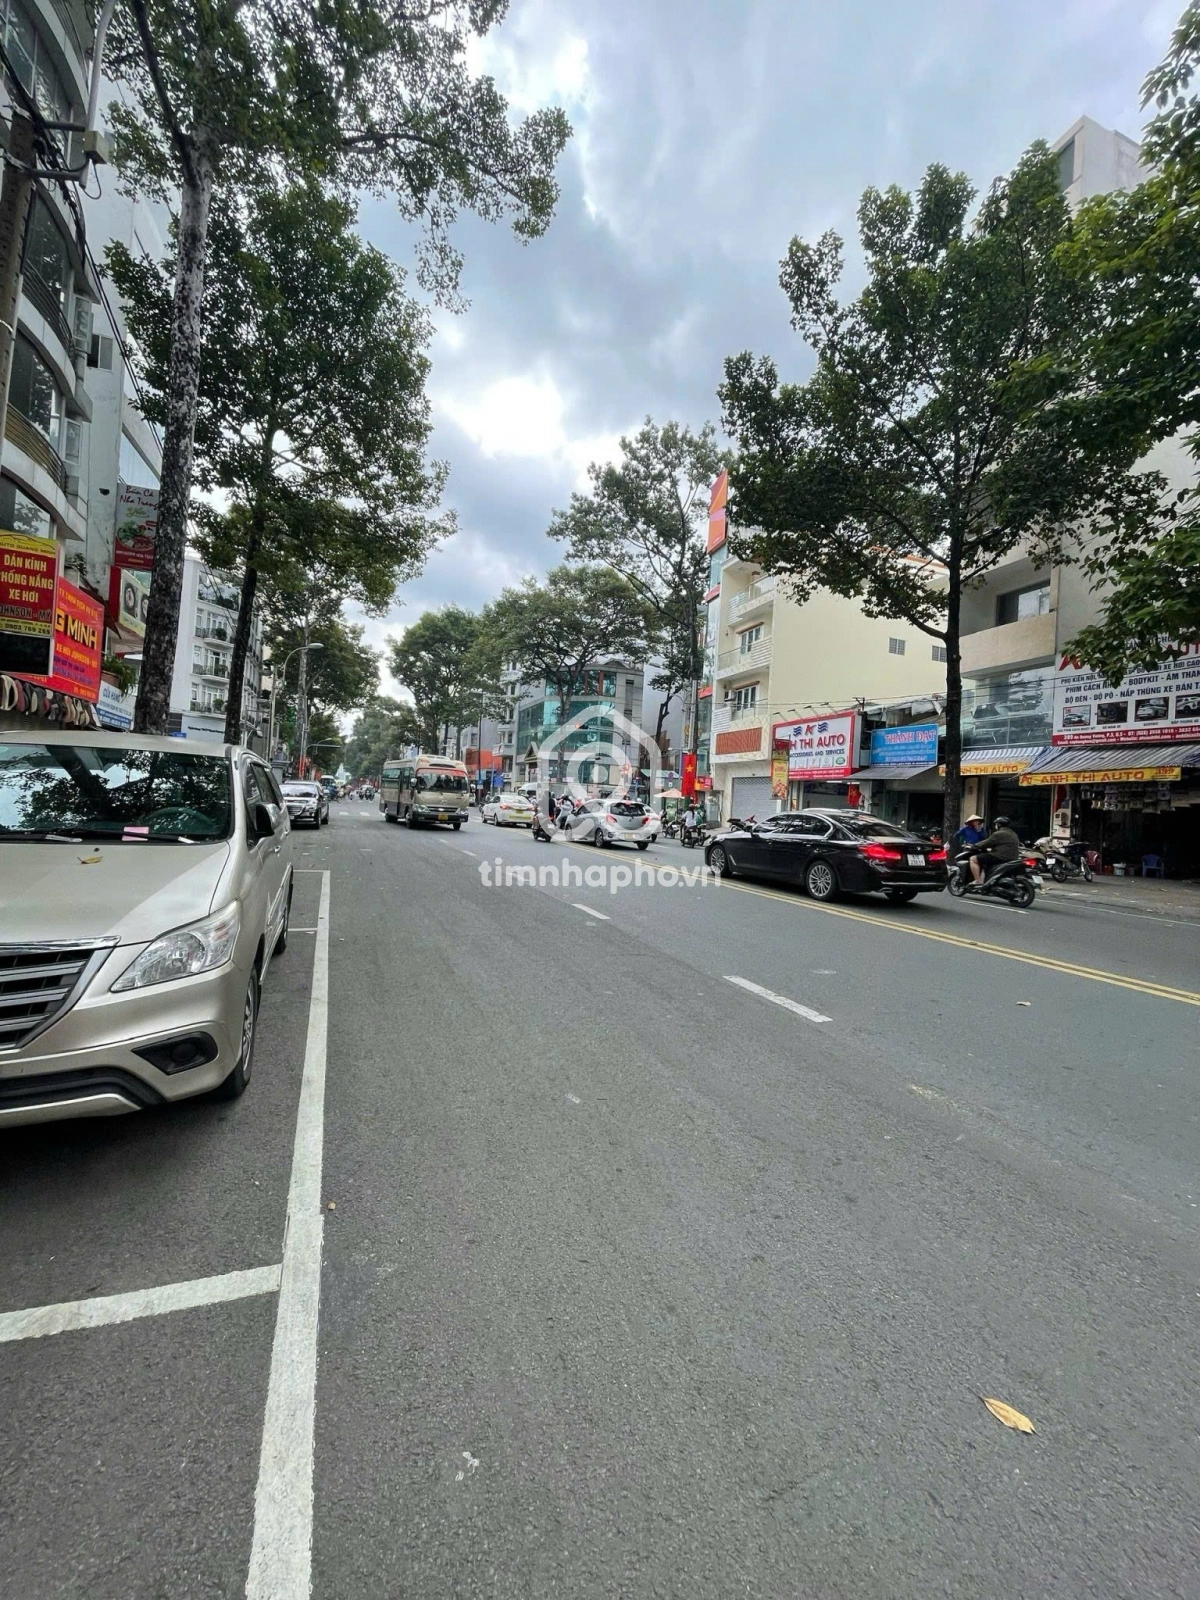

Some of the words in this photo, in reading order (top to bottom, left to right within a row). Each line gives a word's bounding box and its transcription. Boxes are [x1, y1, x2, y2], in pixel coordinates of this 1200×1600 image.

[4, 553, 23, 568] DÁN
[25, 557, 47, 572] KÍNH
[0, 569, 27, 586] HỐNG
[29, 573, 53, 590] NẮNG
[9, 588, 20, 600] XE
[22, 590, 39, 603] HƠI
[67, 614, 98, 650] MINH
[1072, 675, 1085, 683] KIỆN
[1129, 675, 1159, 686] BODYKIT
[1065, 695, 1073, 704] ĐỘ
[1094, 692, 1103, 701] ĐỘ
[1137, 685, 1161, 695] THÙNG
[1163, 685, 1174, 693] XE
[1066, 685, 1082, 693] PHIM
[1083, 682, 1101, 692] CÁCH
[799, 737, 813, 750] THI
[816, 733, 846, 748] AUTO
[916, 729, 937, 744] ĐẠT
[825, 748, 845, 756] SERVICES
[992, 765, 1018, 773] AUTO
[1040, 774, 1069, 784] ANH
[1072, 772, 1095, 782] THI
[1100, 770, 1145, 781] AUTO
